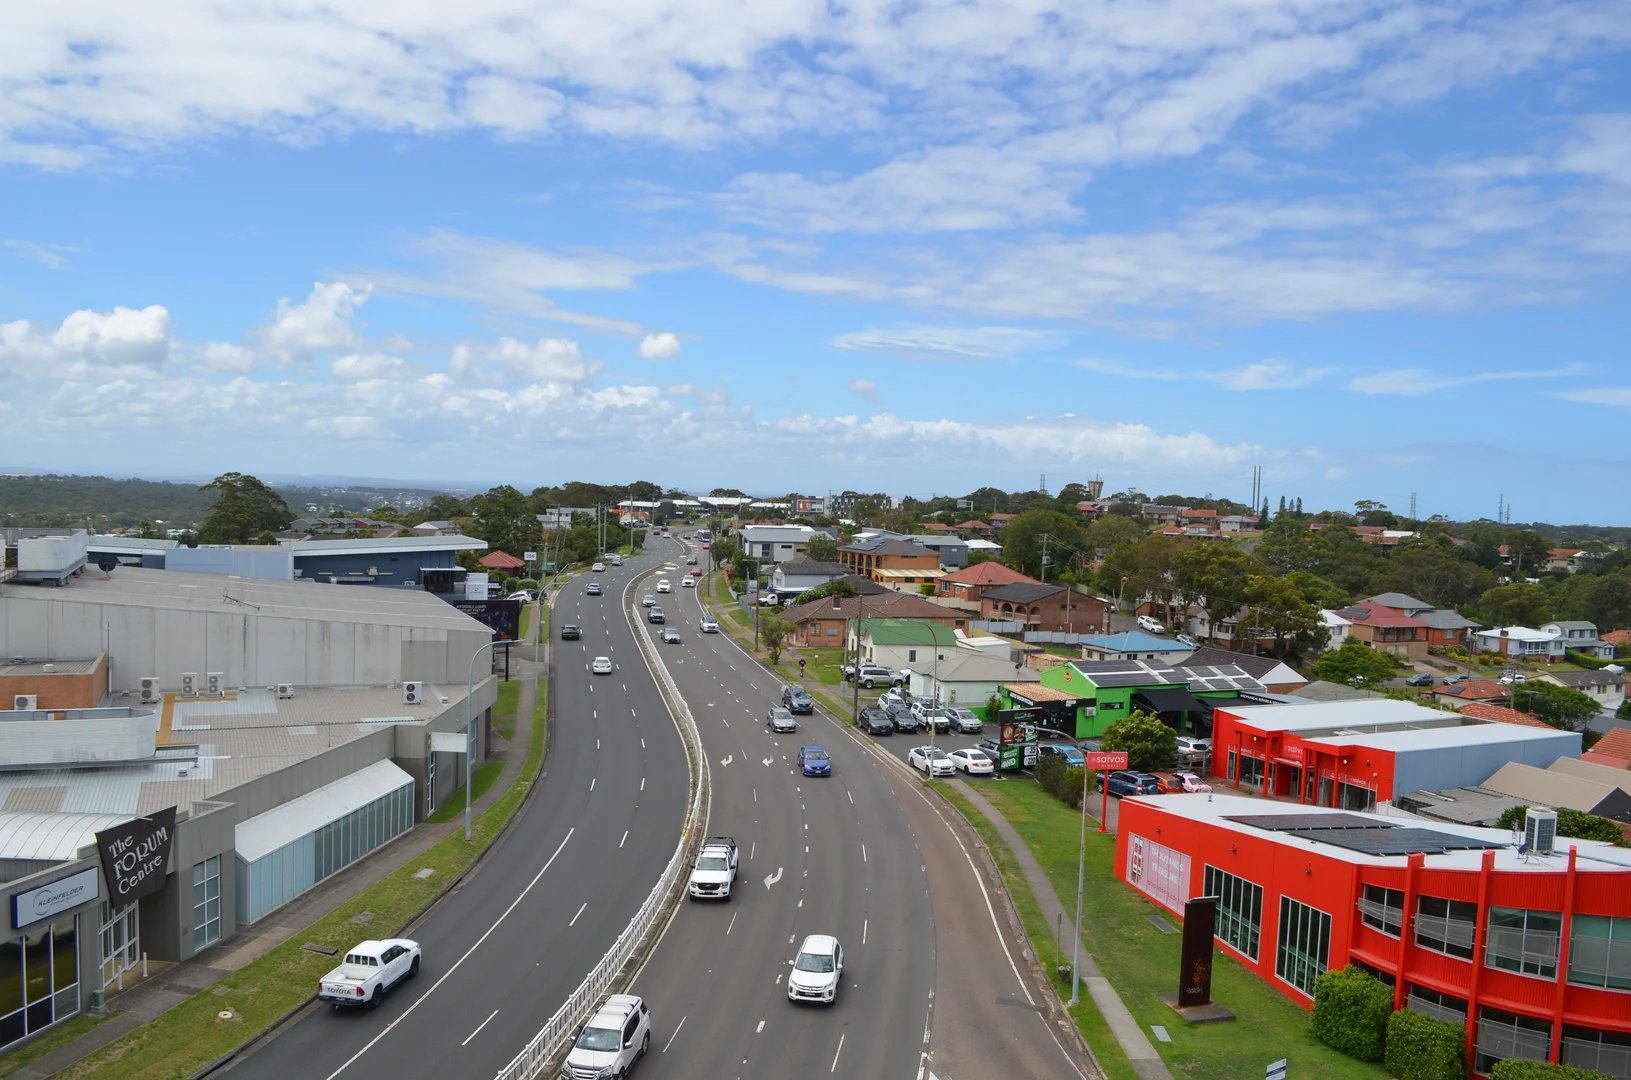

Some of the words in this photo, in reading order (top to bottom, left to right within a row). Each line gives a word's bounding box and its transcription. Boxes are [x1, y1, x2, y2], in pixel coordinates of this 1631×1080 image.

[1001, 757, 1016, 769] 4WD
[1096, 755, 1125, 763] salvos
[108, 835, 134, 858] The
[113, 826, 168, 880] FORUM
[118, 855, 163, 894] Centre
[38, 885, 84, 907] KLEINFELDER
[327, 987, 352, 995] TOYOTA
